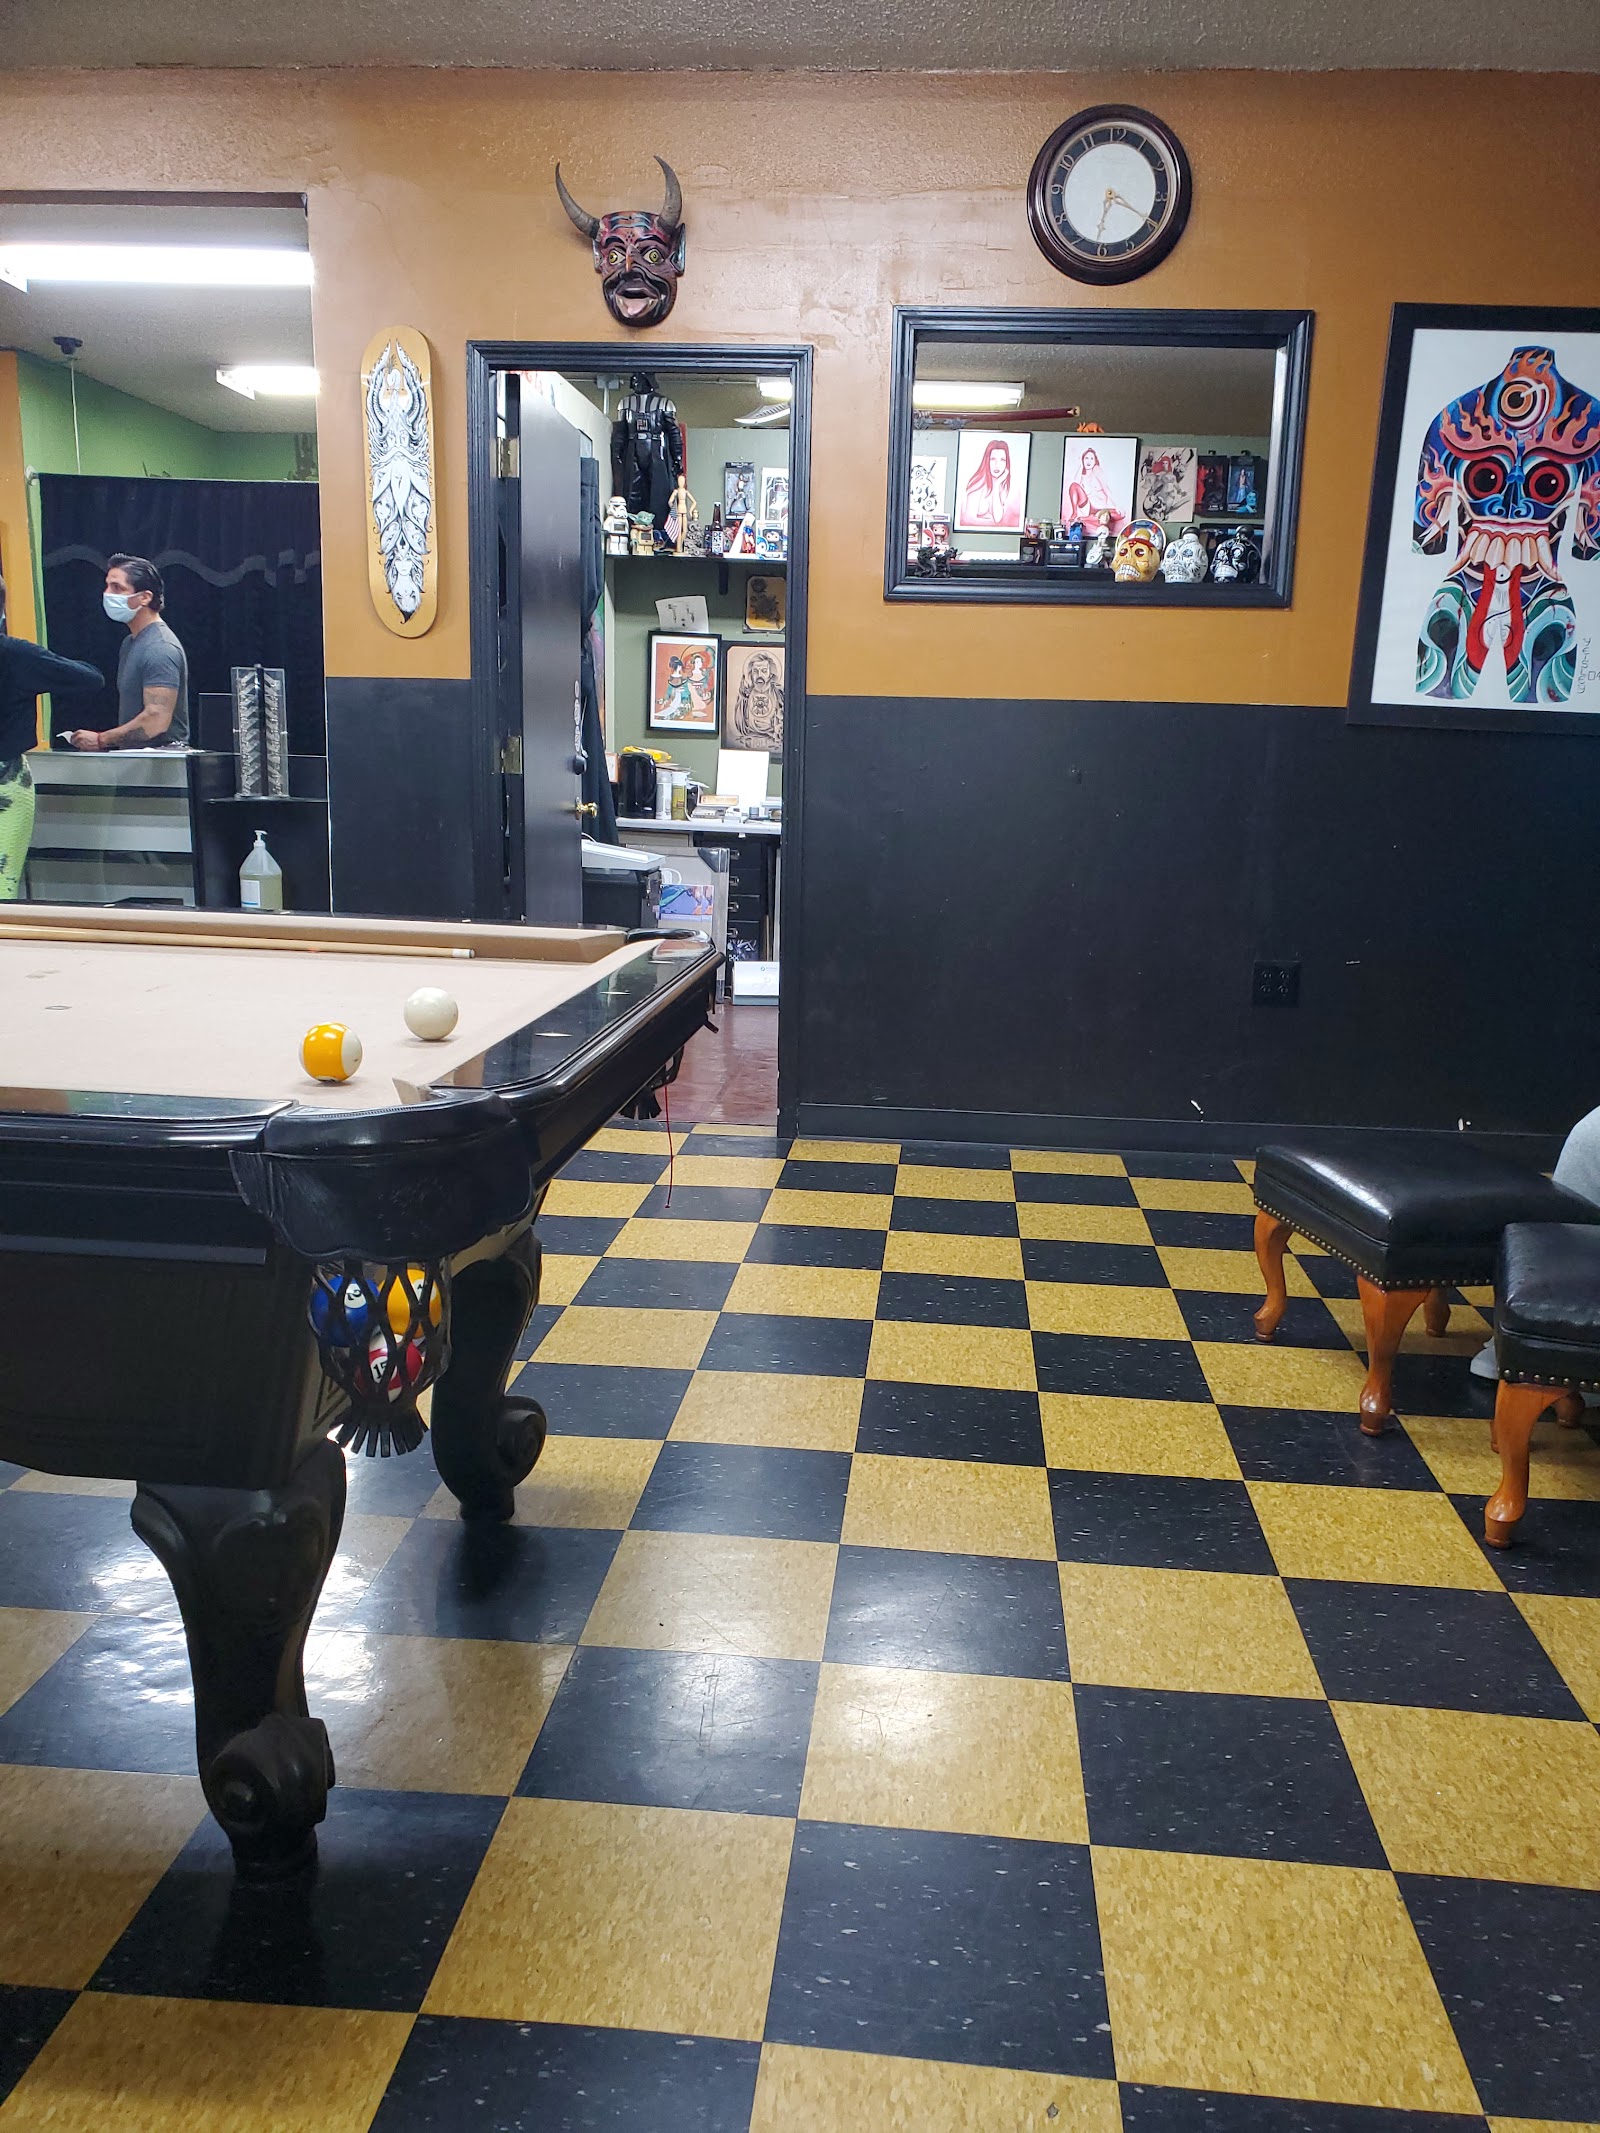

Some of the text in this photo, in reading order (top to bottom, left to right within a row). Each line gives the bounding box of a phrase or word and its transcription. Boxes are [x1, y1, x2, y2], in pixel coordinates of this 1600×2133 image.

[1081, 133, 1095, 150] 11
[1109, 127, 1127, 143] 12
[1137, 138, 1148, 152] 1
[1059, 154, 1075, 171] 10
[1151, 160, 1166, 172] 2
[1051, 184, 1065, 195] 9
[1155, 191, 1168, 202] 3
[1055, 213, 1069, 225] 8
[1070, 233, 1086, 246] 7
[1125, 238, 1135, 252] 5
[1097, 243, 1108, 257] 6
